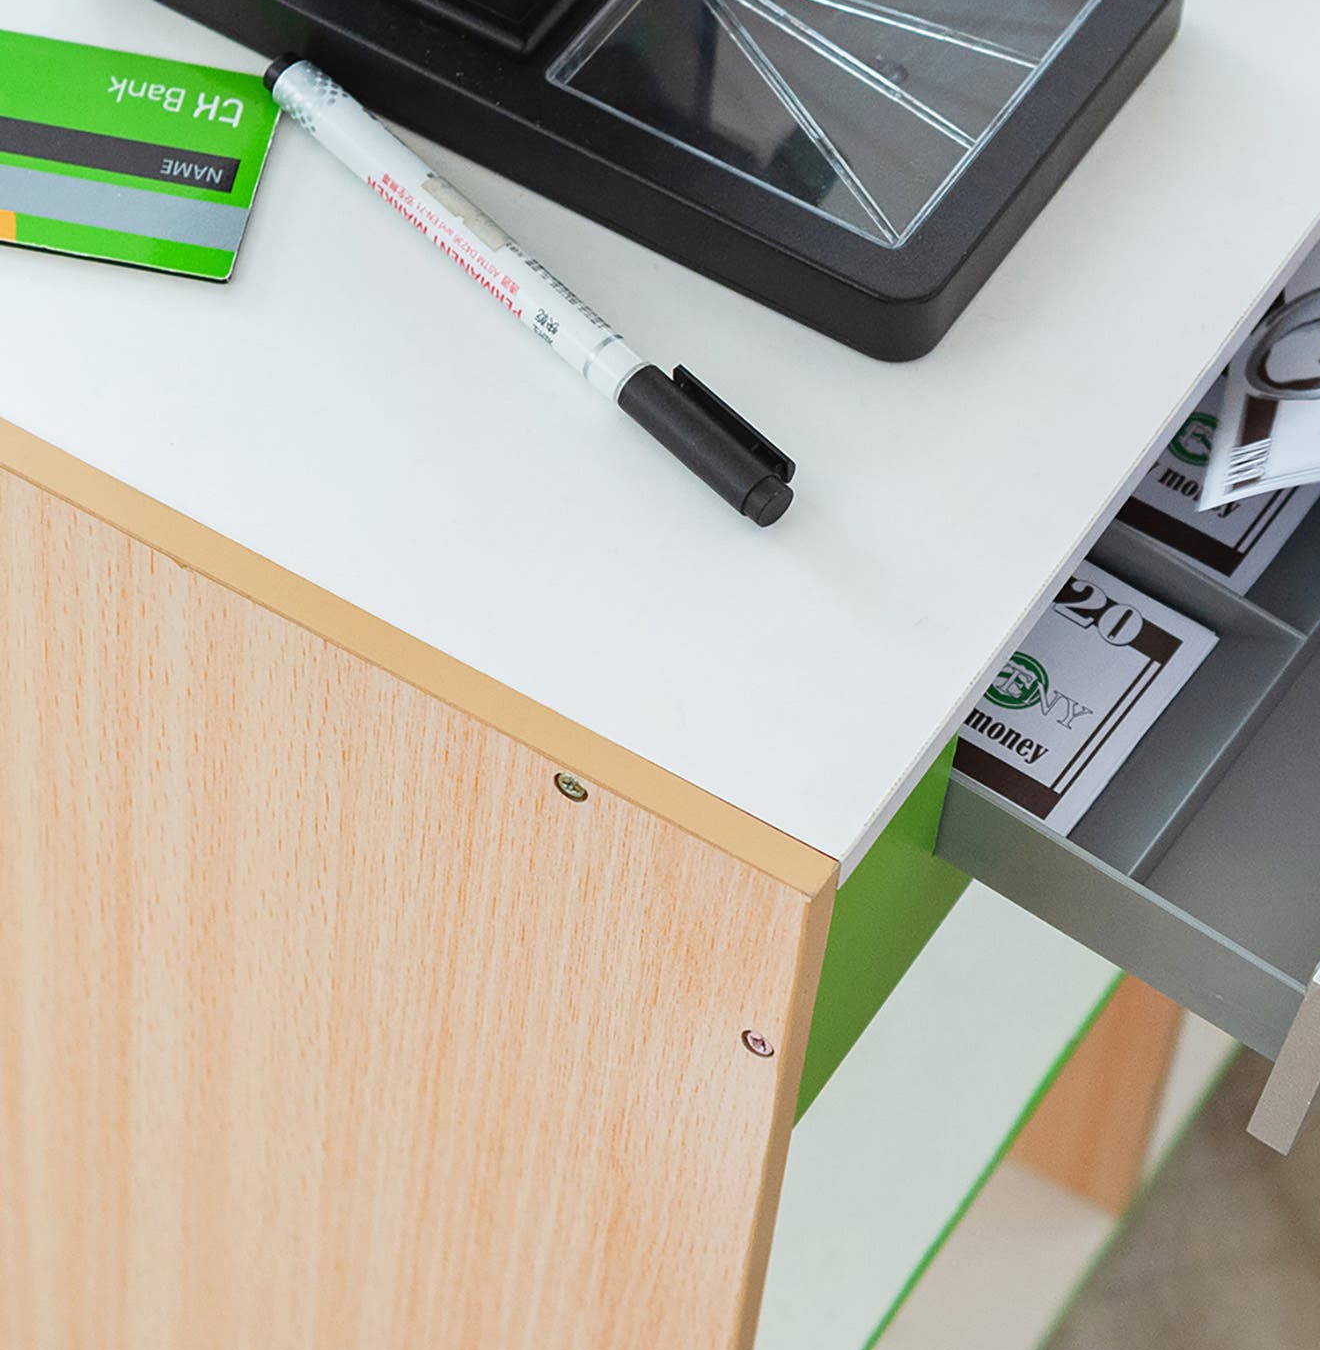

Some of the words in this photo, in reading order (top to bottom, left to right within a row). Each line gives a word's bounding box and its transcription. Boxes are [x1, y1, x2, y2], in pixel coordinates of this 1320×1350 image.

[107, 75, 187, 113] Bank
[160, 158, 224, 184] NAME
[476, 255, 500, 279] ASTM
[1052, 579, 1144, 647] 20
[963, 707, 1050, 765] money
